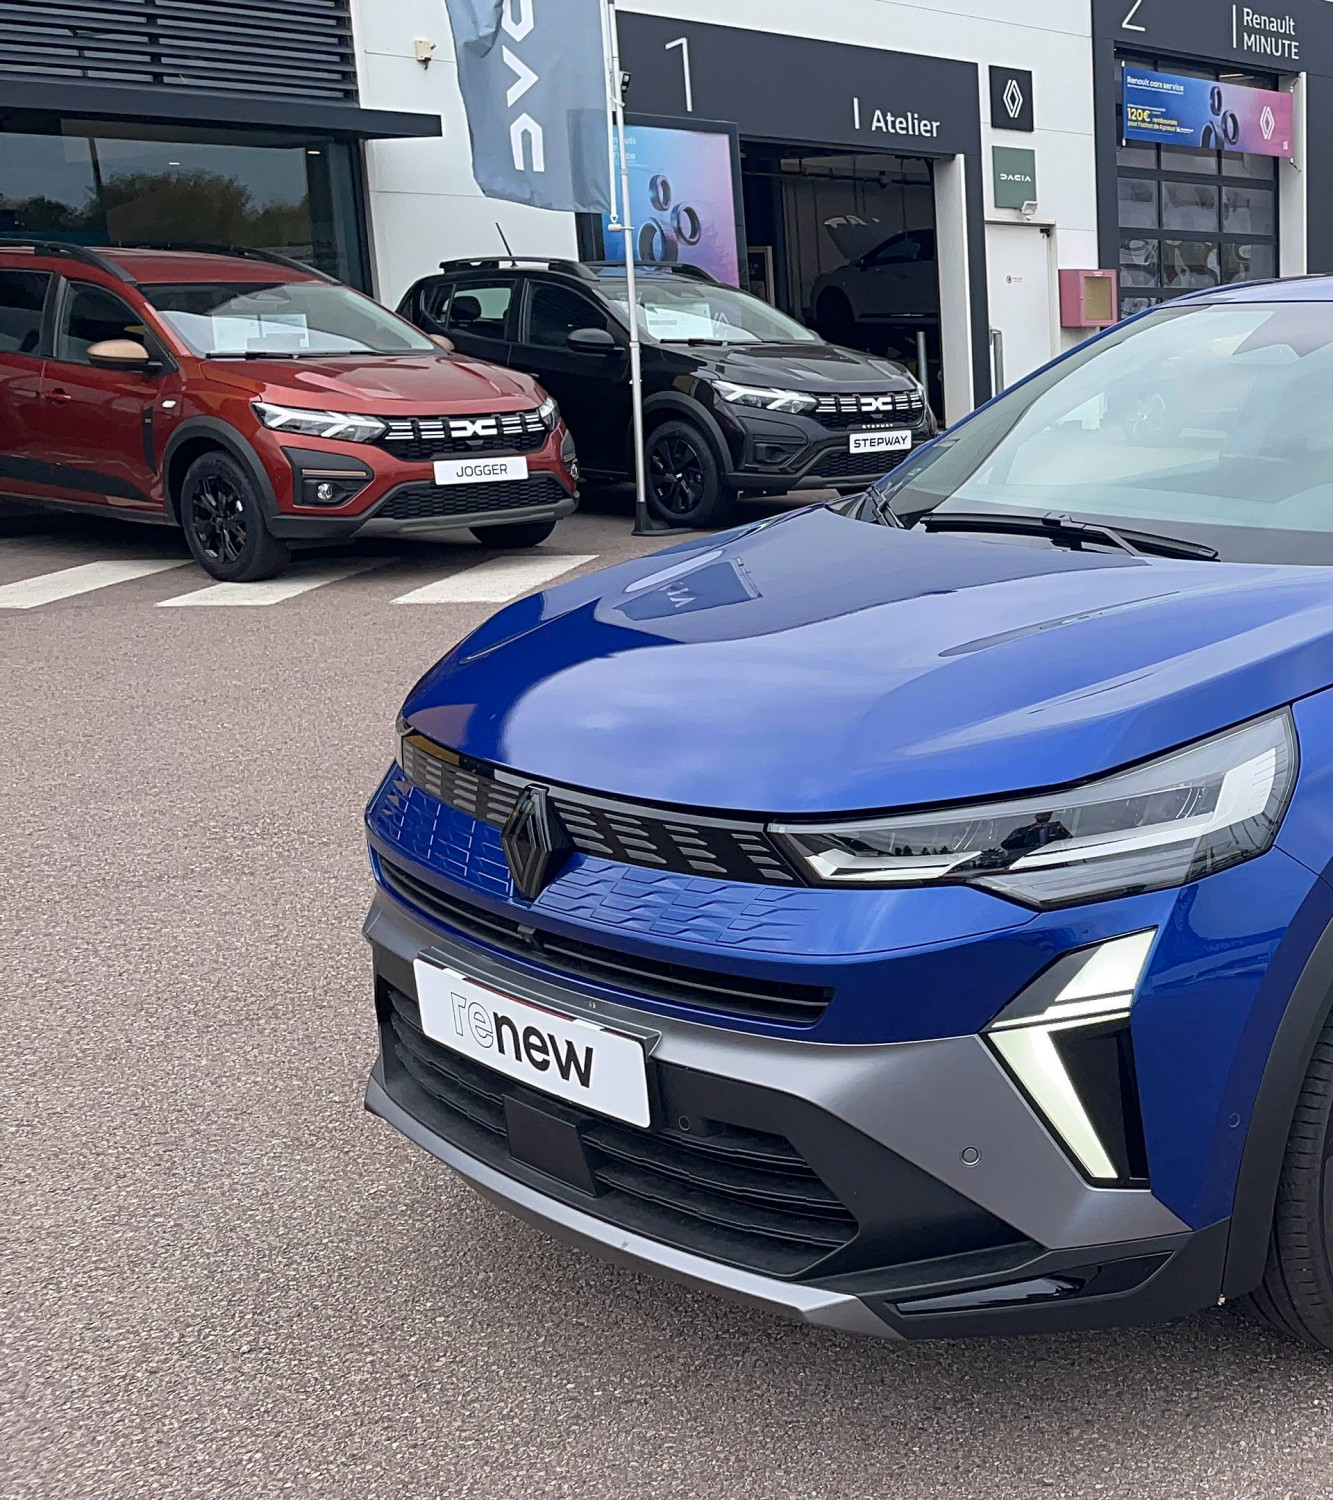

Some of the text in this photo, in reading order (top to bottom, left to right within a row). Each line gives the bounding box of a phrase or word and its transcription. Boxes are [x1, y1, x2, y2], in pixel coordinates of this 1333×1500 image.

[1243, 8, 1295, 35] Renault
[1243, 32, 1299, 60] MINUTE
[665, 37, 695, 112] 1
[1126, 75, 1149, 87] Renault
[1163, 83, 1184, 92] service
[871, 109, 940, 137] Atelier
[1126, 107, 1151, 122] 120€
[1000, 173, 1032, 182] DACIA
[853, 435, 908, 449] STEPWAY
[456, 463, 508, 478] JOGGER
[450, 991, 594, 1089] renew
